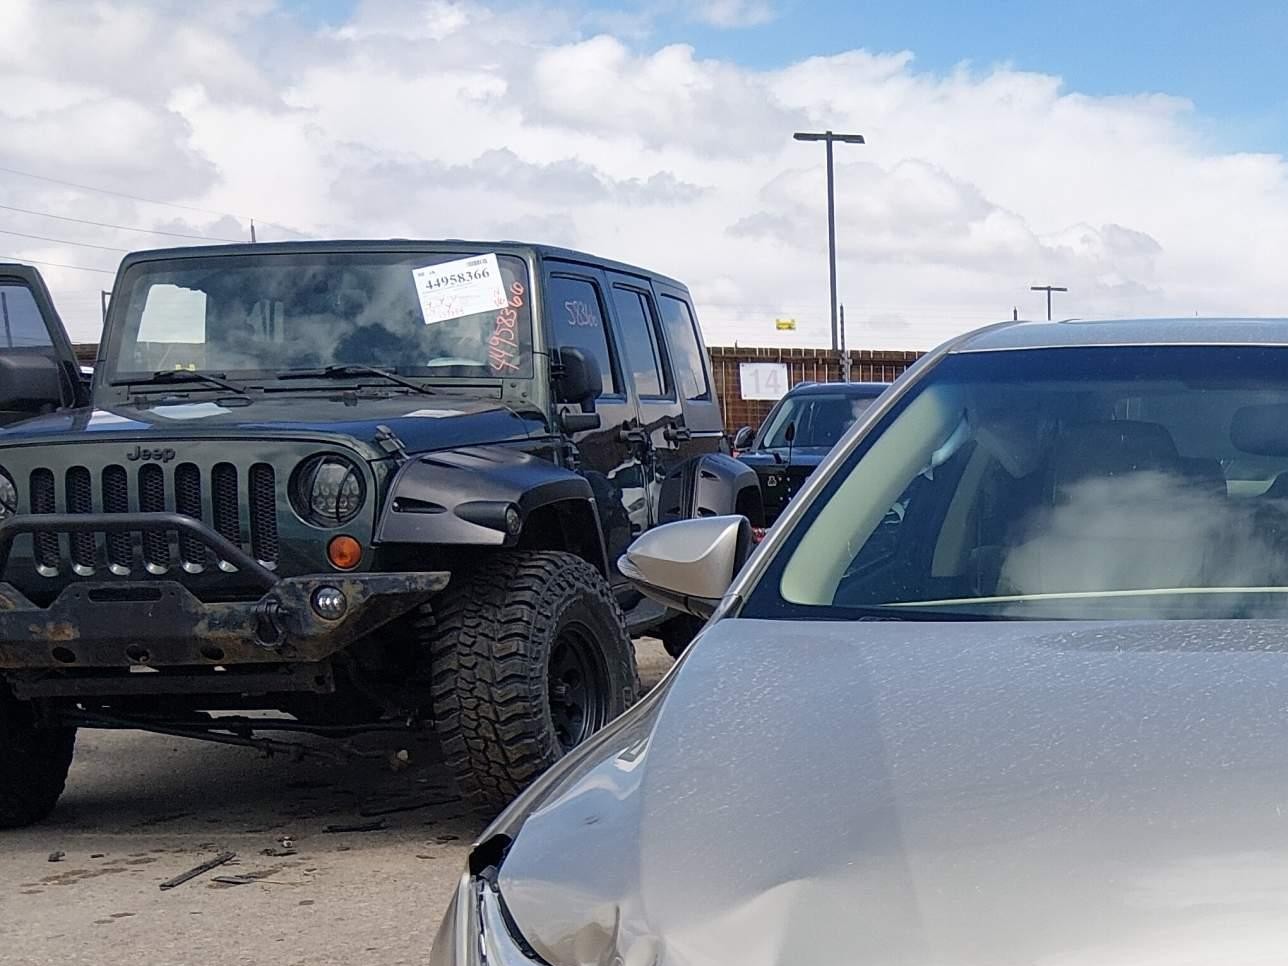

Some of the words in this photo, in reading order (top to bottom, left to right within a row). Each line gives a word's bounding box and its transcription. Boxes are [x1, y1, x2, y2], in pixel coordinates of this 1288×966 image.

[425, 267, 490, 290] 44958366
[749, 368, 782, 394] 14
[126, 446, 176, 463] Jeep
